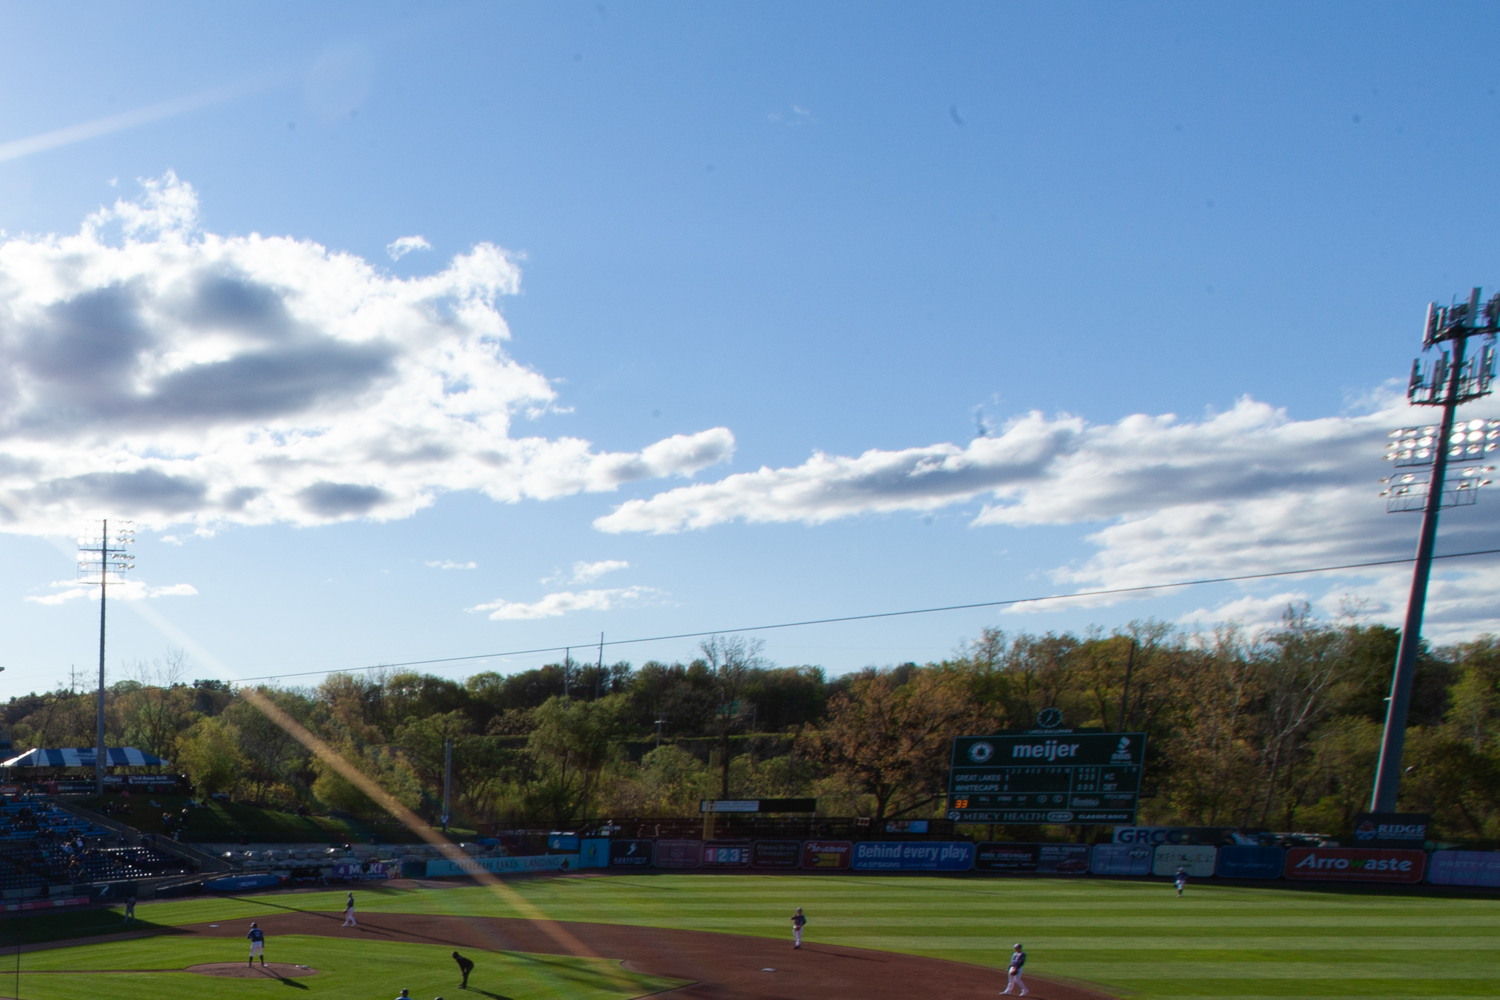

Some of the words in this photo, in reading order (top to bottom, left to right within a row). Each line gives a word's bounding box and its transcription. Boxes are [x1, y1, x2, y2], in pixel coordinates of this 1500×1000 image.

[1012, 740, 1080, 762] meijer
[955, 799, 969, 809] 33
[1117, 829, 1182, 843] GRCC
[1378, 825, 1426, 834] RIDGE
[857, 844, 901, 858] Behind
[903, 846, 939, 861] every
[940, 844, 969, 861] play.
[496, 861, 519, 870] LAKES
[523, 858, 559, 868] LANDING
[1295, 853, 1414, 872] Arrowaste
